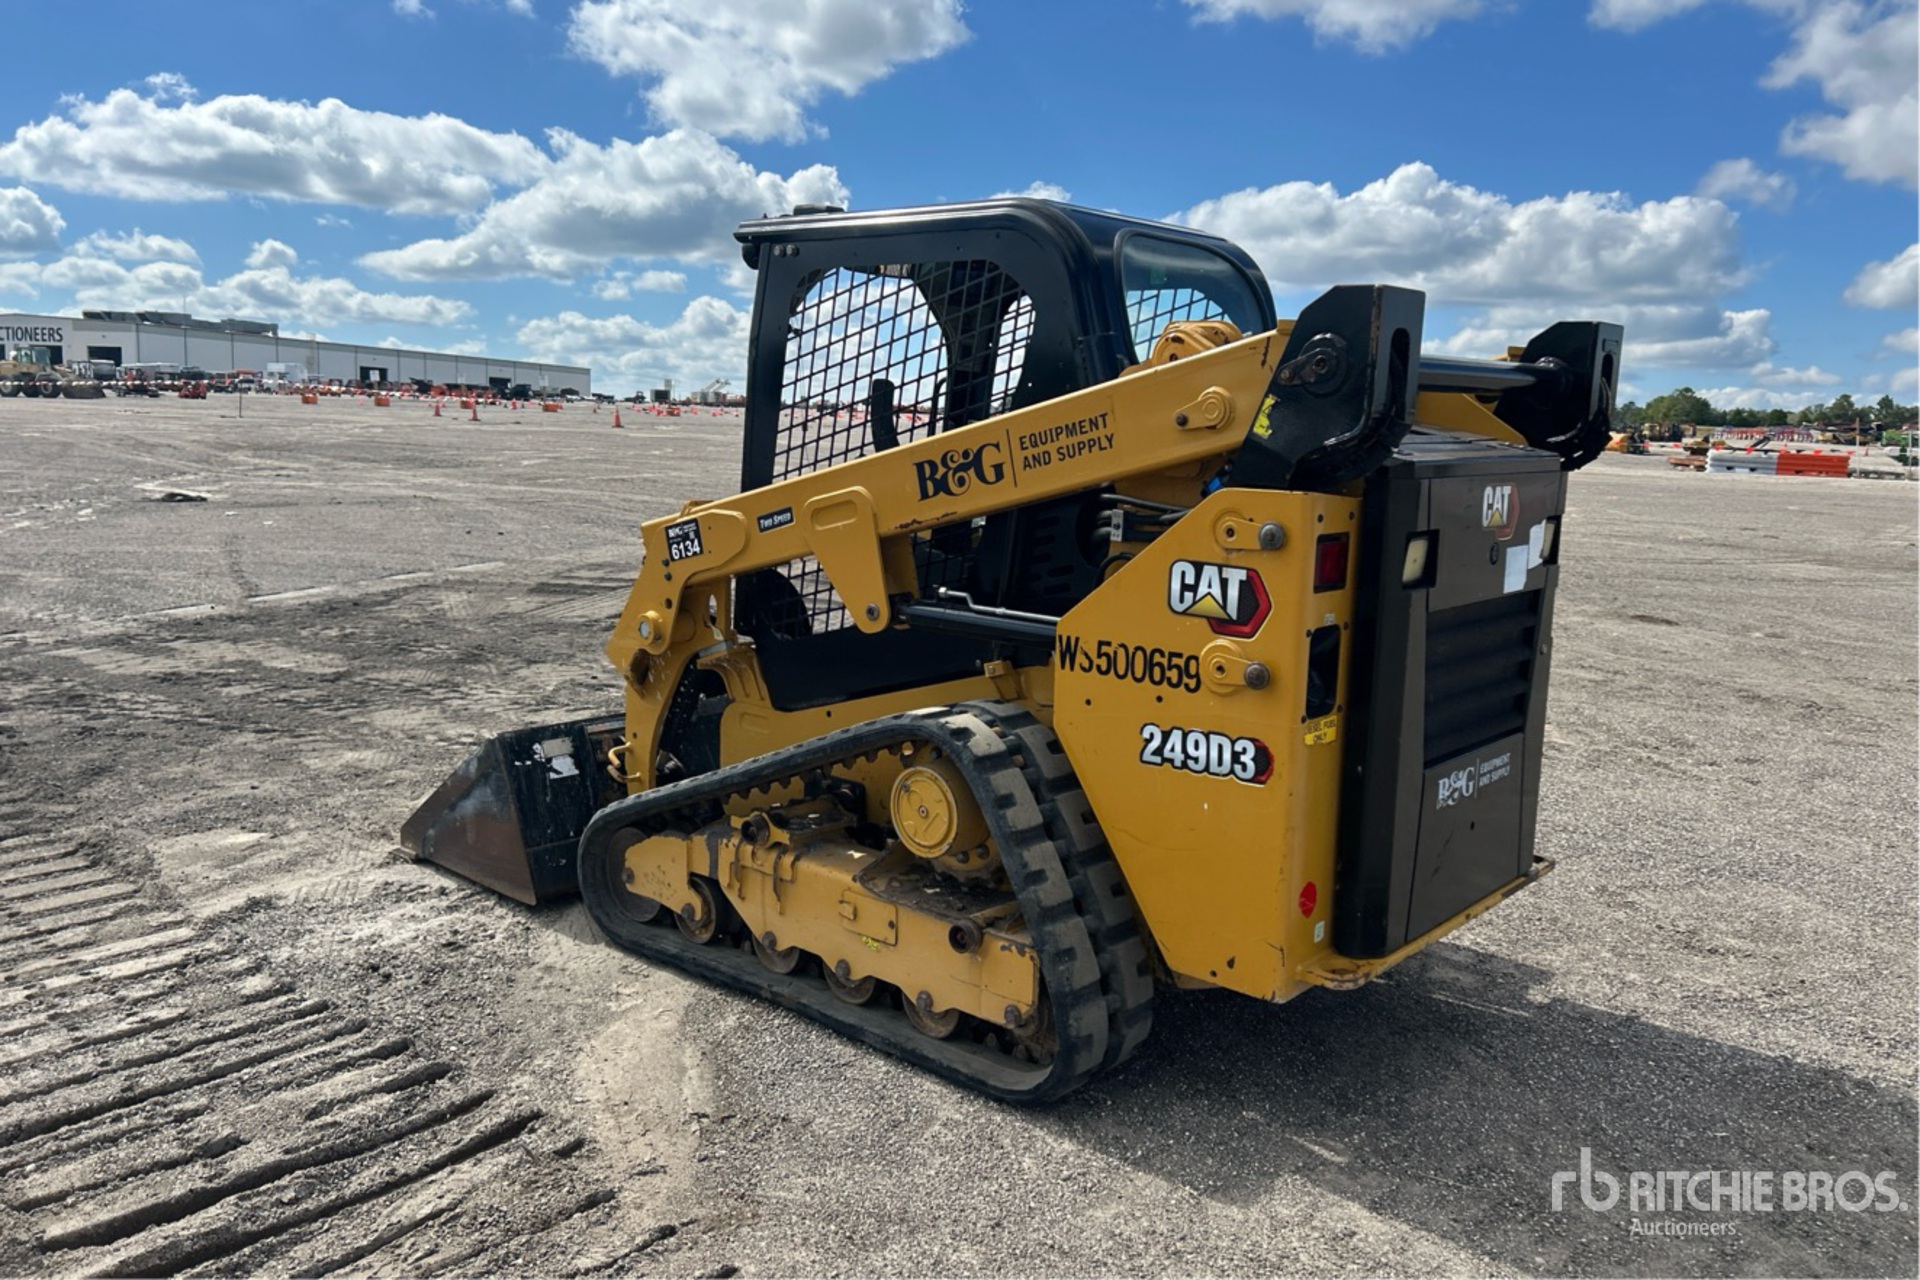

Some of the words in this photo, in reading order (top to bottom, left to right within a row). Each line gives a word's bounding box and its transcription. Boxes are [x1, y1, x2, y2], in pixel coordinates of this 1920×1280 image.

[1019, 413, 1109, 451] EQUIPMENT
[1022, 450, 1052, 471] AND
[1058, 433, 1115, 462] SUPPLY
[912, 441, 1005, 502] B&G
[1482, 485, 1512, 528] CAT
[671, 538, 701, 560] 6134
[1170, 560, 1248, 621] CAT
[1140, 724, 1257, 781] 249D3
[1436, 766, 1475, 809] B&G
